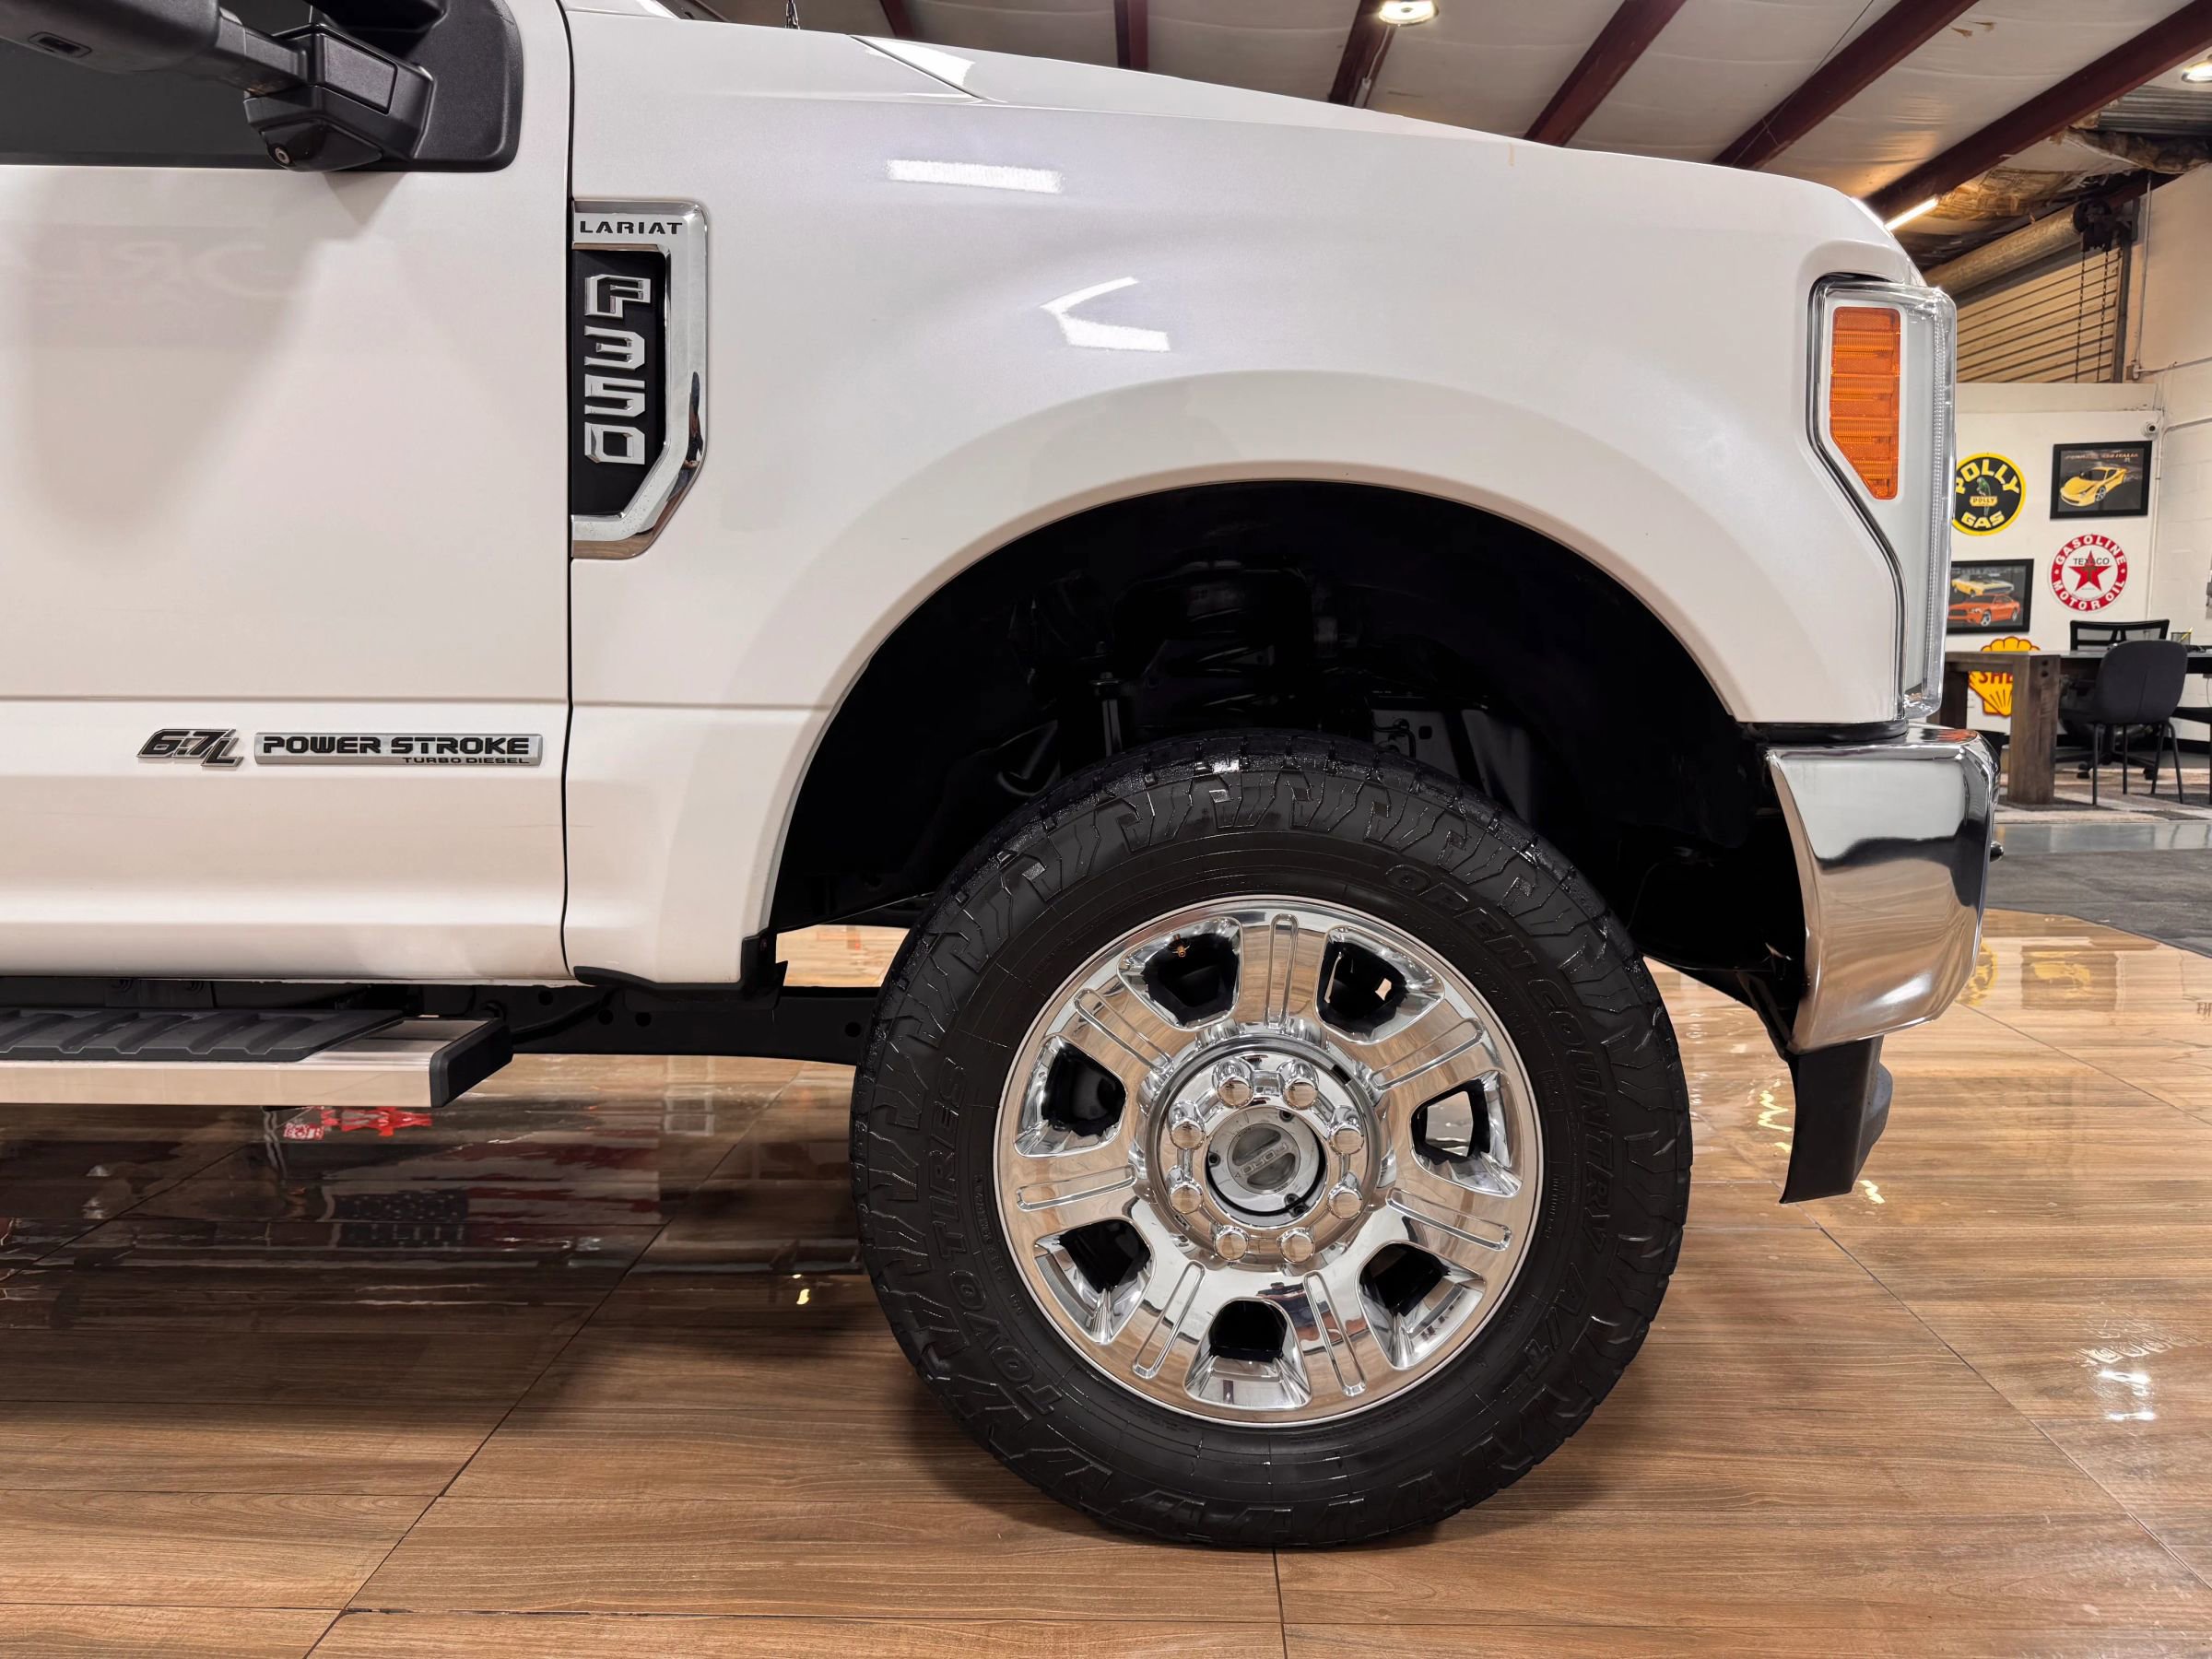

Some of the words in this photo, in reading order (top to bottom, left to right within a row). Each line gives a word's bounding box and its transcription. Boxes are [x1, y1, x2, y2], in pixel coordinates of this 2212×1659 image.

[580, 220, 683, 235] LARIAT
[584, 274, 651, 465] F350
[1961, 511, 2005, 529] GAS
[2055, 535, 2125, 565] GASOLINE
[2053, 580, 2100, 610] MOTOR
[2105, 581, 2125, 602] OIL
[263, 735, 381, 755] POWER
[390, 736, 529, 756] STROKE
[466, 757, 530, 765] DIESEL
[1385, 864, 1537, 970] OPEN
[1527, 979, 1614, 1253] COUNTRY
[929, 1056, 967, 1261] TIRES
[1241, 1142, 1288, 1175] FORD
[948, 1269, 1063, 1415] TOYO
